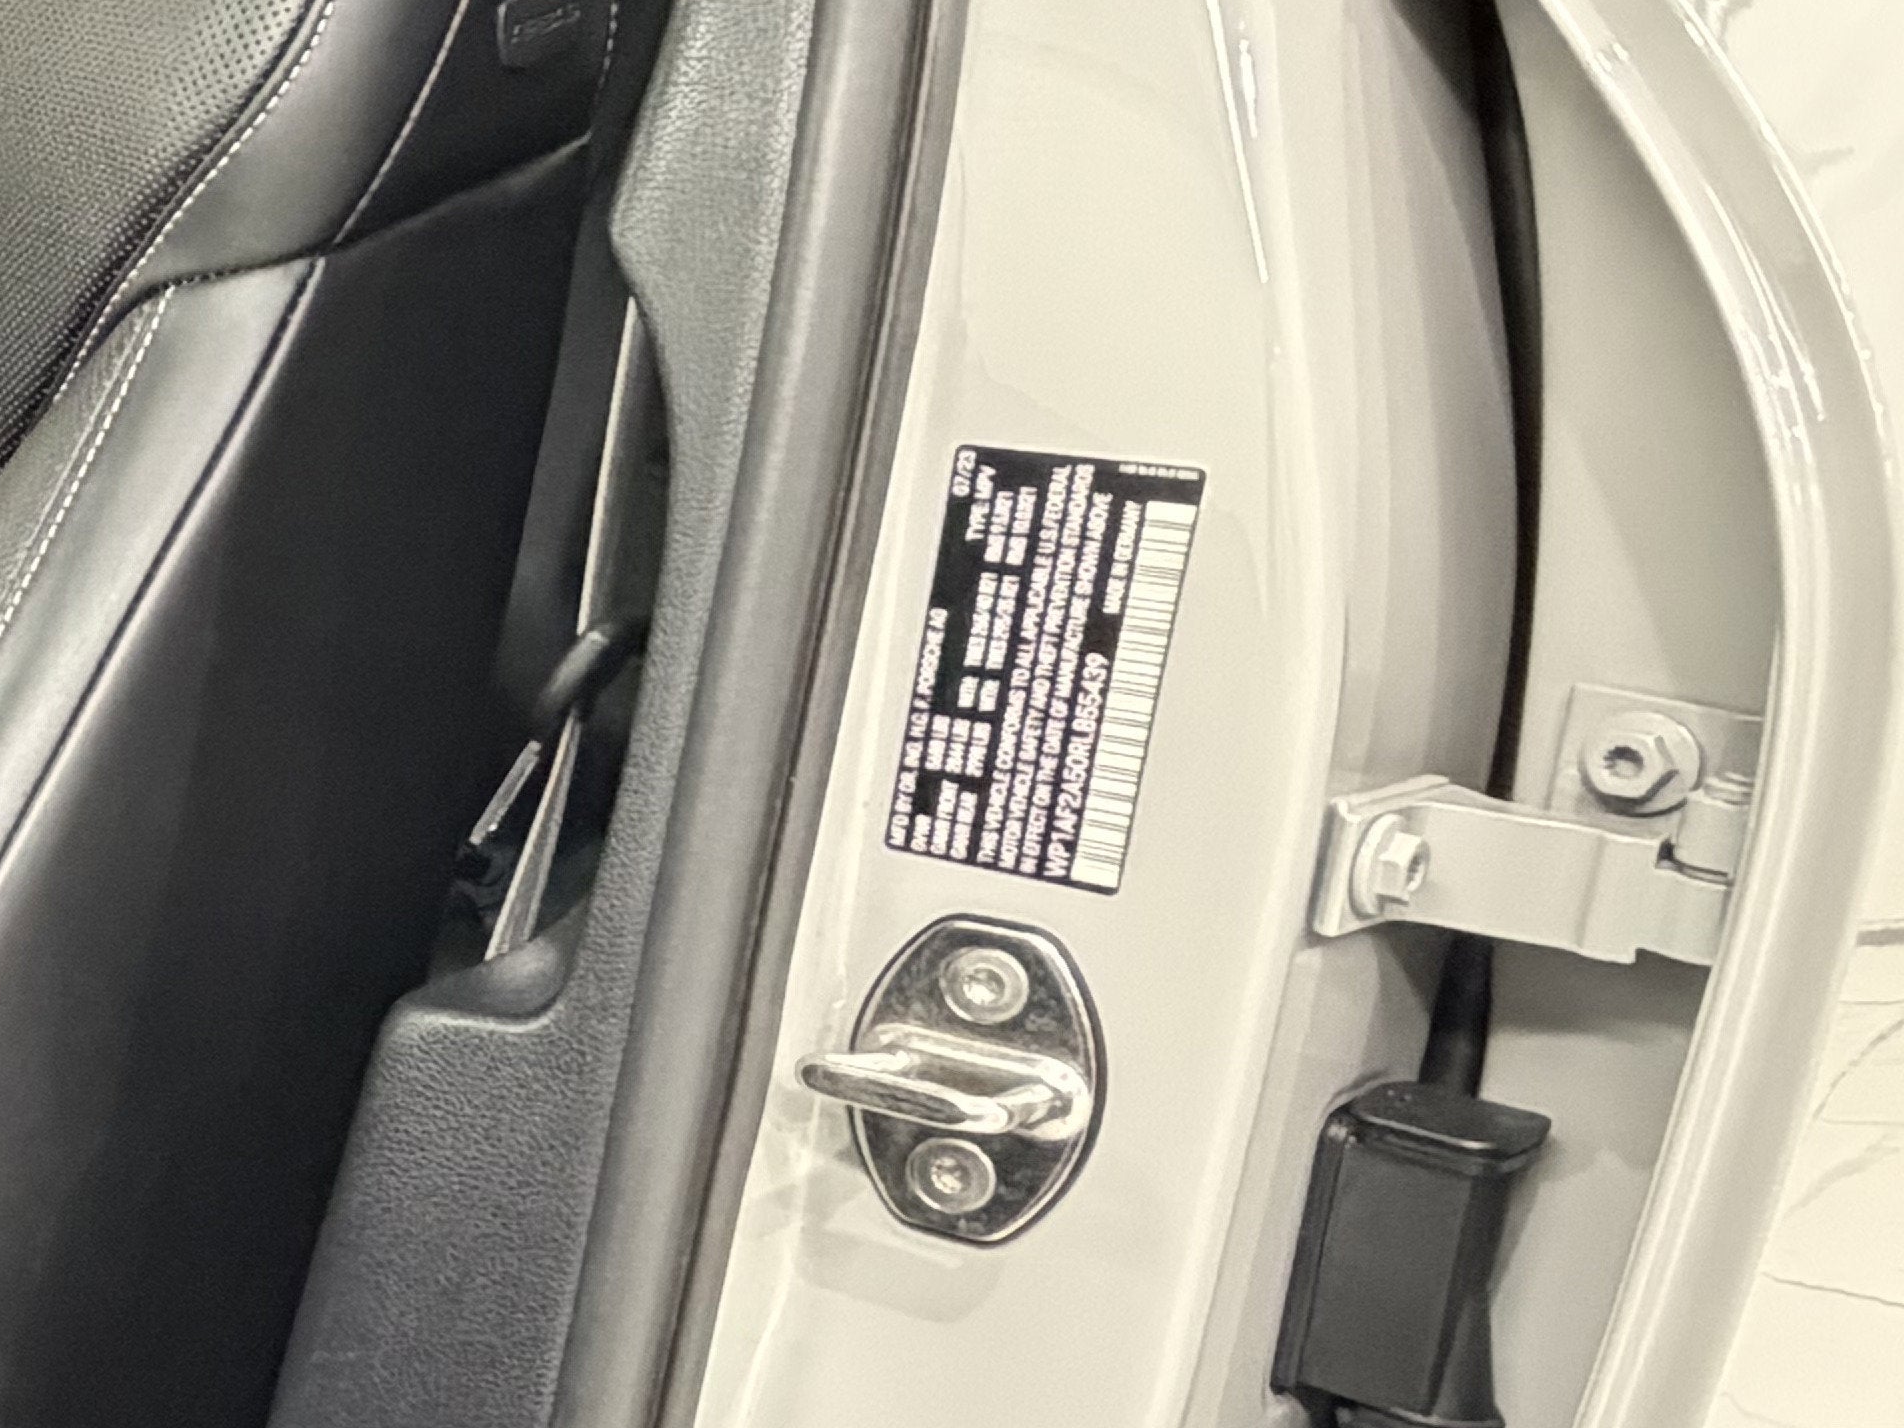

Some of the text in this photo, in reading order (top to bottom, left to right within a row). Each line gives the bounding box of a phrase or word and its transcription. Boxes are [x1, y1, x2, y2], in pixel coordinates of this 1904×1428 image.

[952, 449, 976, 496] 07/23
[1061, 464, 1094, 546] STANDARDS
[1113, 500, 1140, 561] GERMANY
[1020, 555, 1052, 640] APPLICABLE
[1043, 547, 1075, 633] PREVENTION
[916, 629, 943, 695] PORSCHE
[1034, 633, 1058, 676] THEFT
[1022, 805, 1046, 856] EFFECT
[1054, 596, 1089, 697] MANUFACTURE
[1074, 540, 1100, 595] SHOWN
[995, 689, 1025, 769] CONFORMS
[1018, 708, 1043, 761] SAFETY
[984, 770, 1010, 829] VEHICLE
[1008, 762, 1034, 818] VEHICLE
[998, 818, 1022, 868] MOTOR
